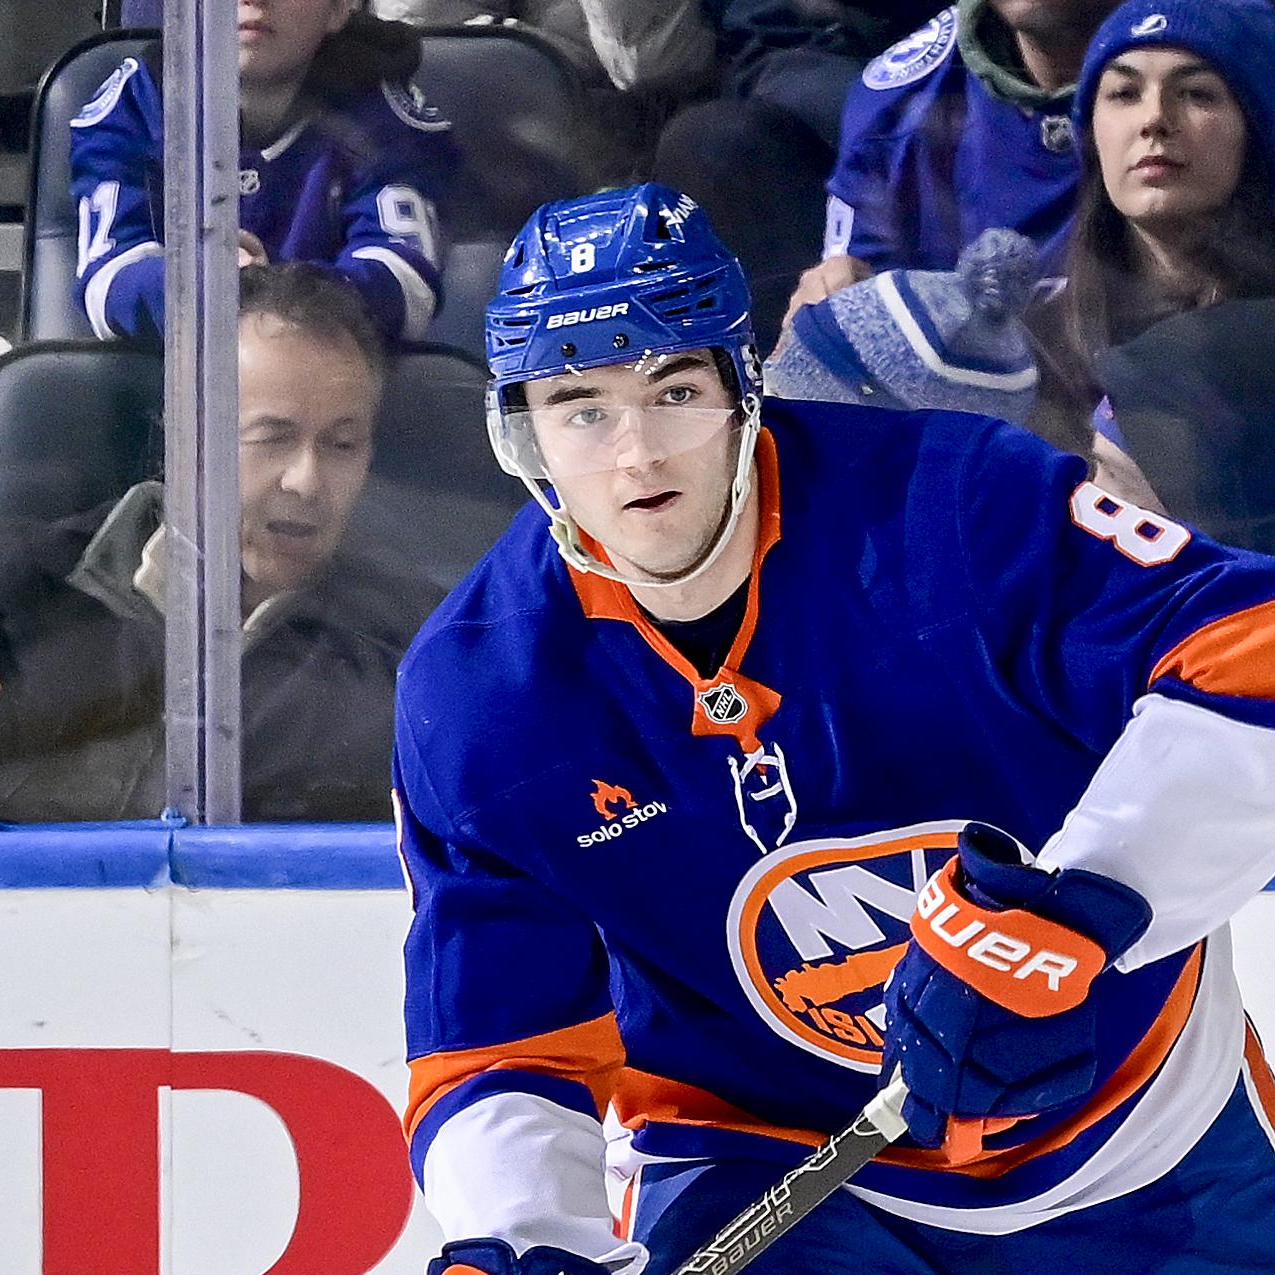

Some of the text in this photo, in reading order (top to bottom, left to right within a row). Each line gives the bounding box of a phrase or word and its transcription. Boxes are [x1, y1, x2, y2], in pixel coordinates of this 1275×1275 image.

[570, 243, 595, 274] 8
[547, 302, 630, 330] BAUER
[1070, 481, 1191, 567] 8
[715, 692, 732, 718] NHL
[577, 822, 623, 848] solo
